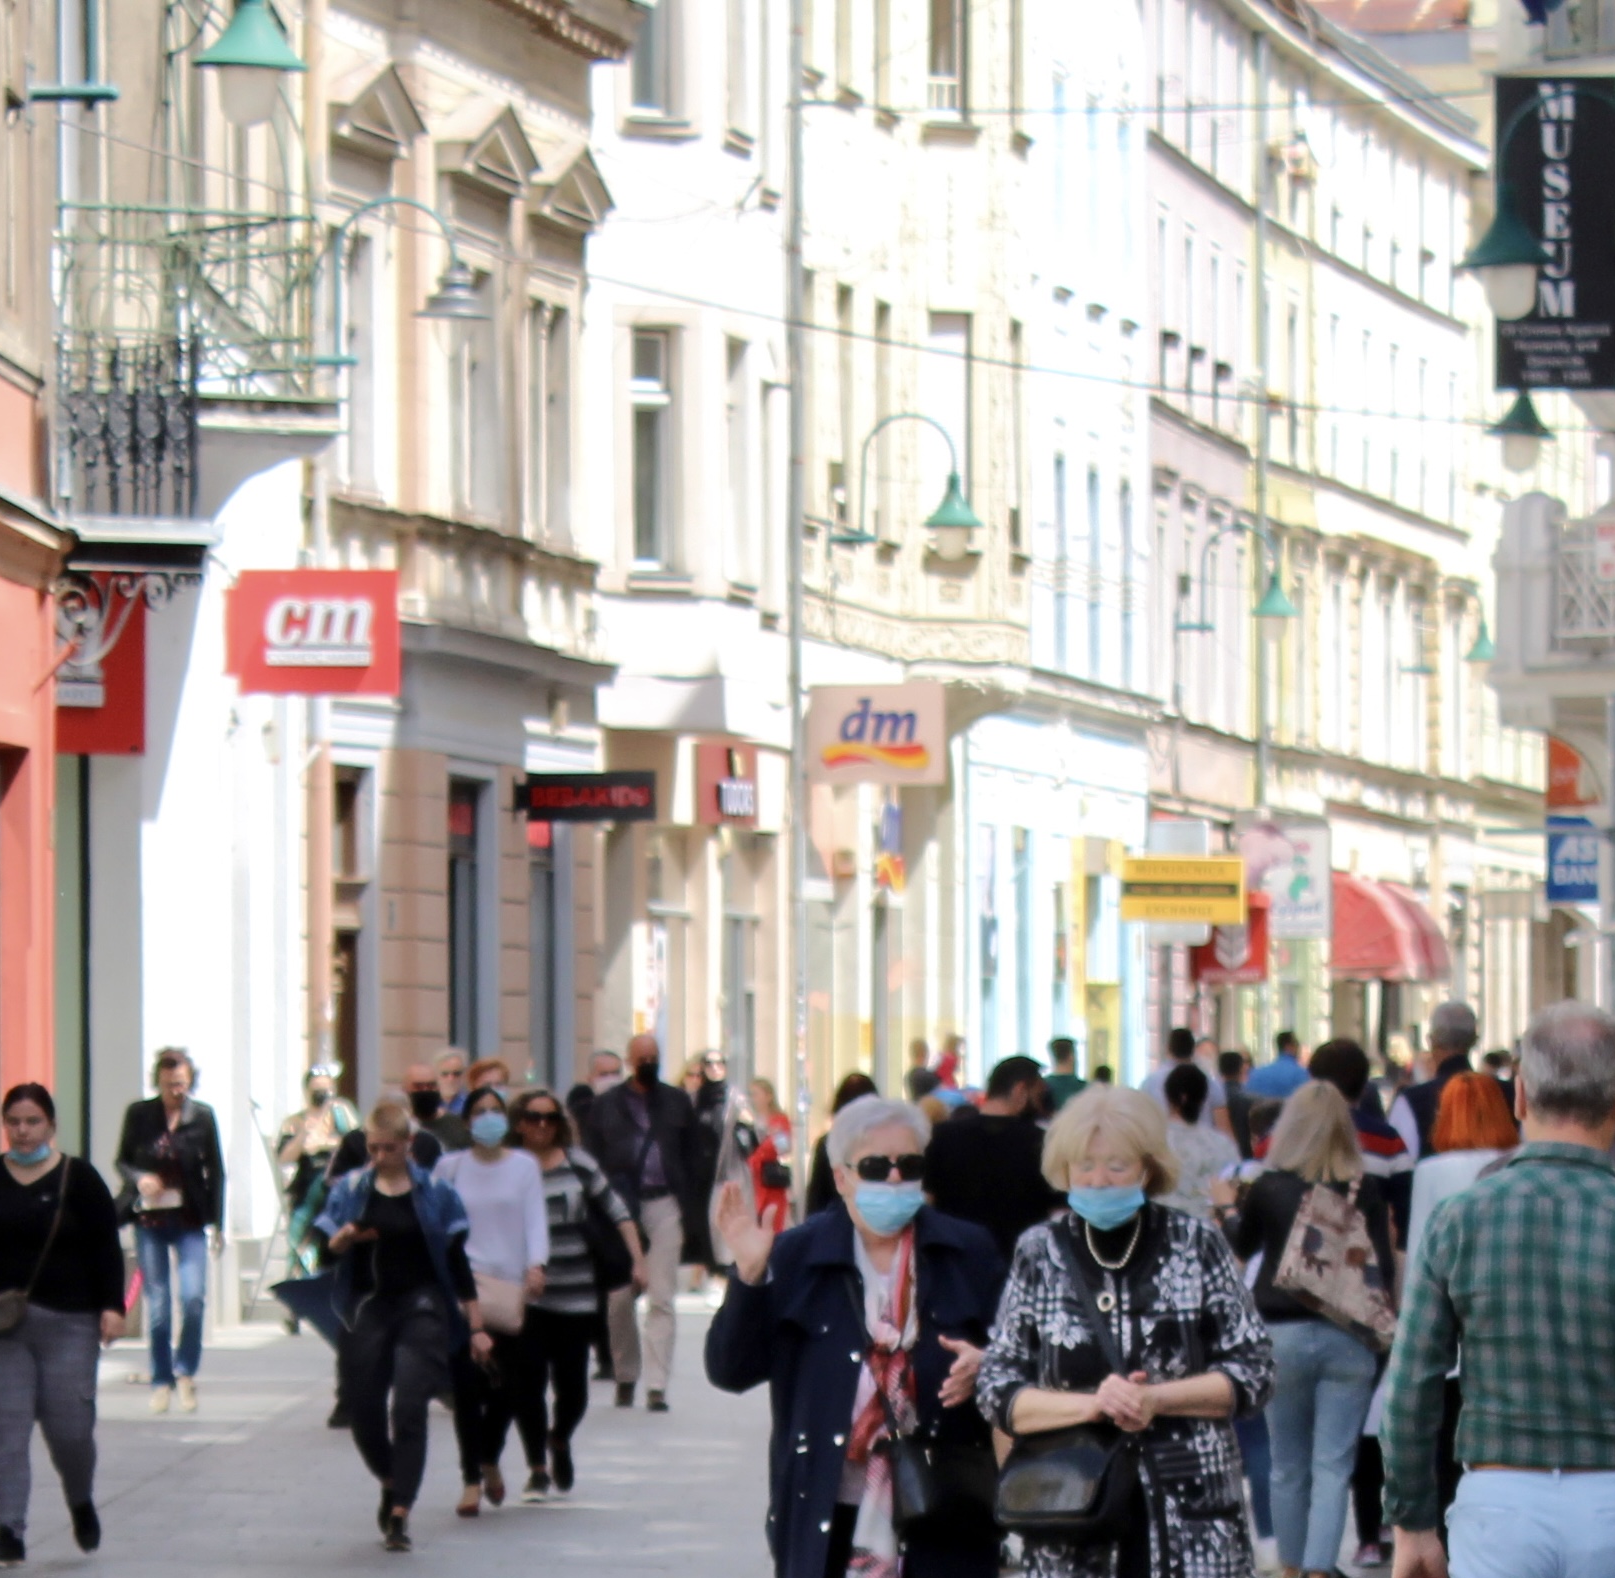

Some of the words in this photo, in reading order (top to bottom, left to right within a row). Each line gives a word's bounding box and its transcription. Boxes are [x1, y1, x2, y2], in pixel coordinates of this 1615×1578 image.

[1539, 83, 1575, 318] MUSEUM
[265, 599, 373, 647] cm
[840, 698, 917, 742] dm
[1554, 834, 1599, 865] AS
[1553, 866, 1599, 886] BAN
